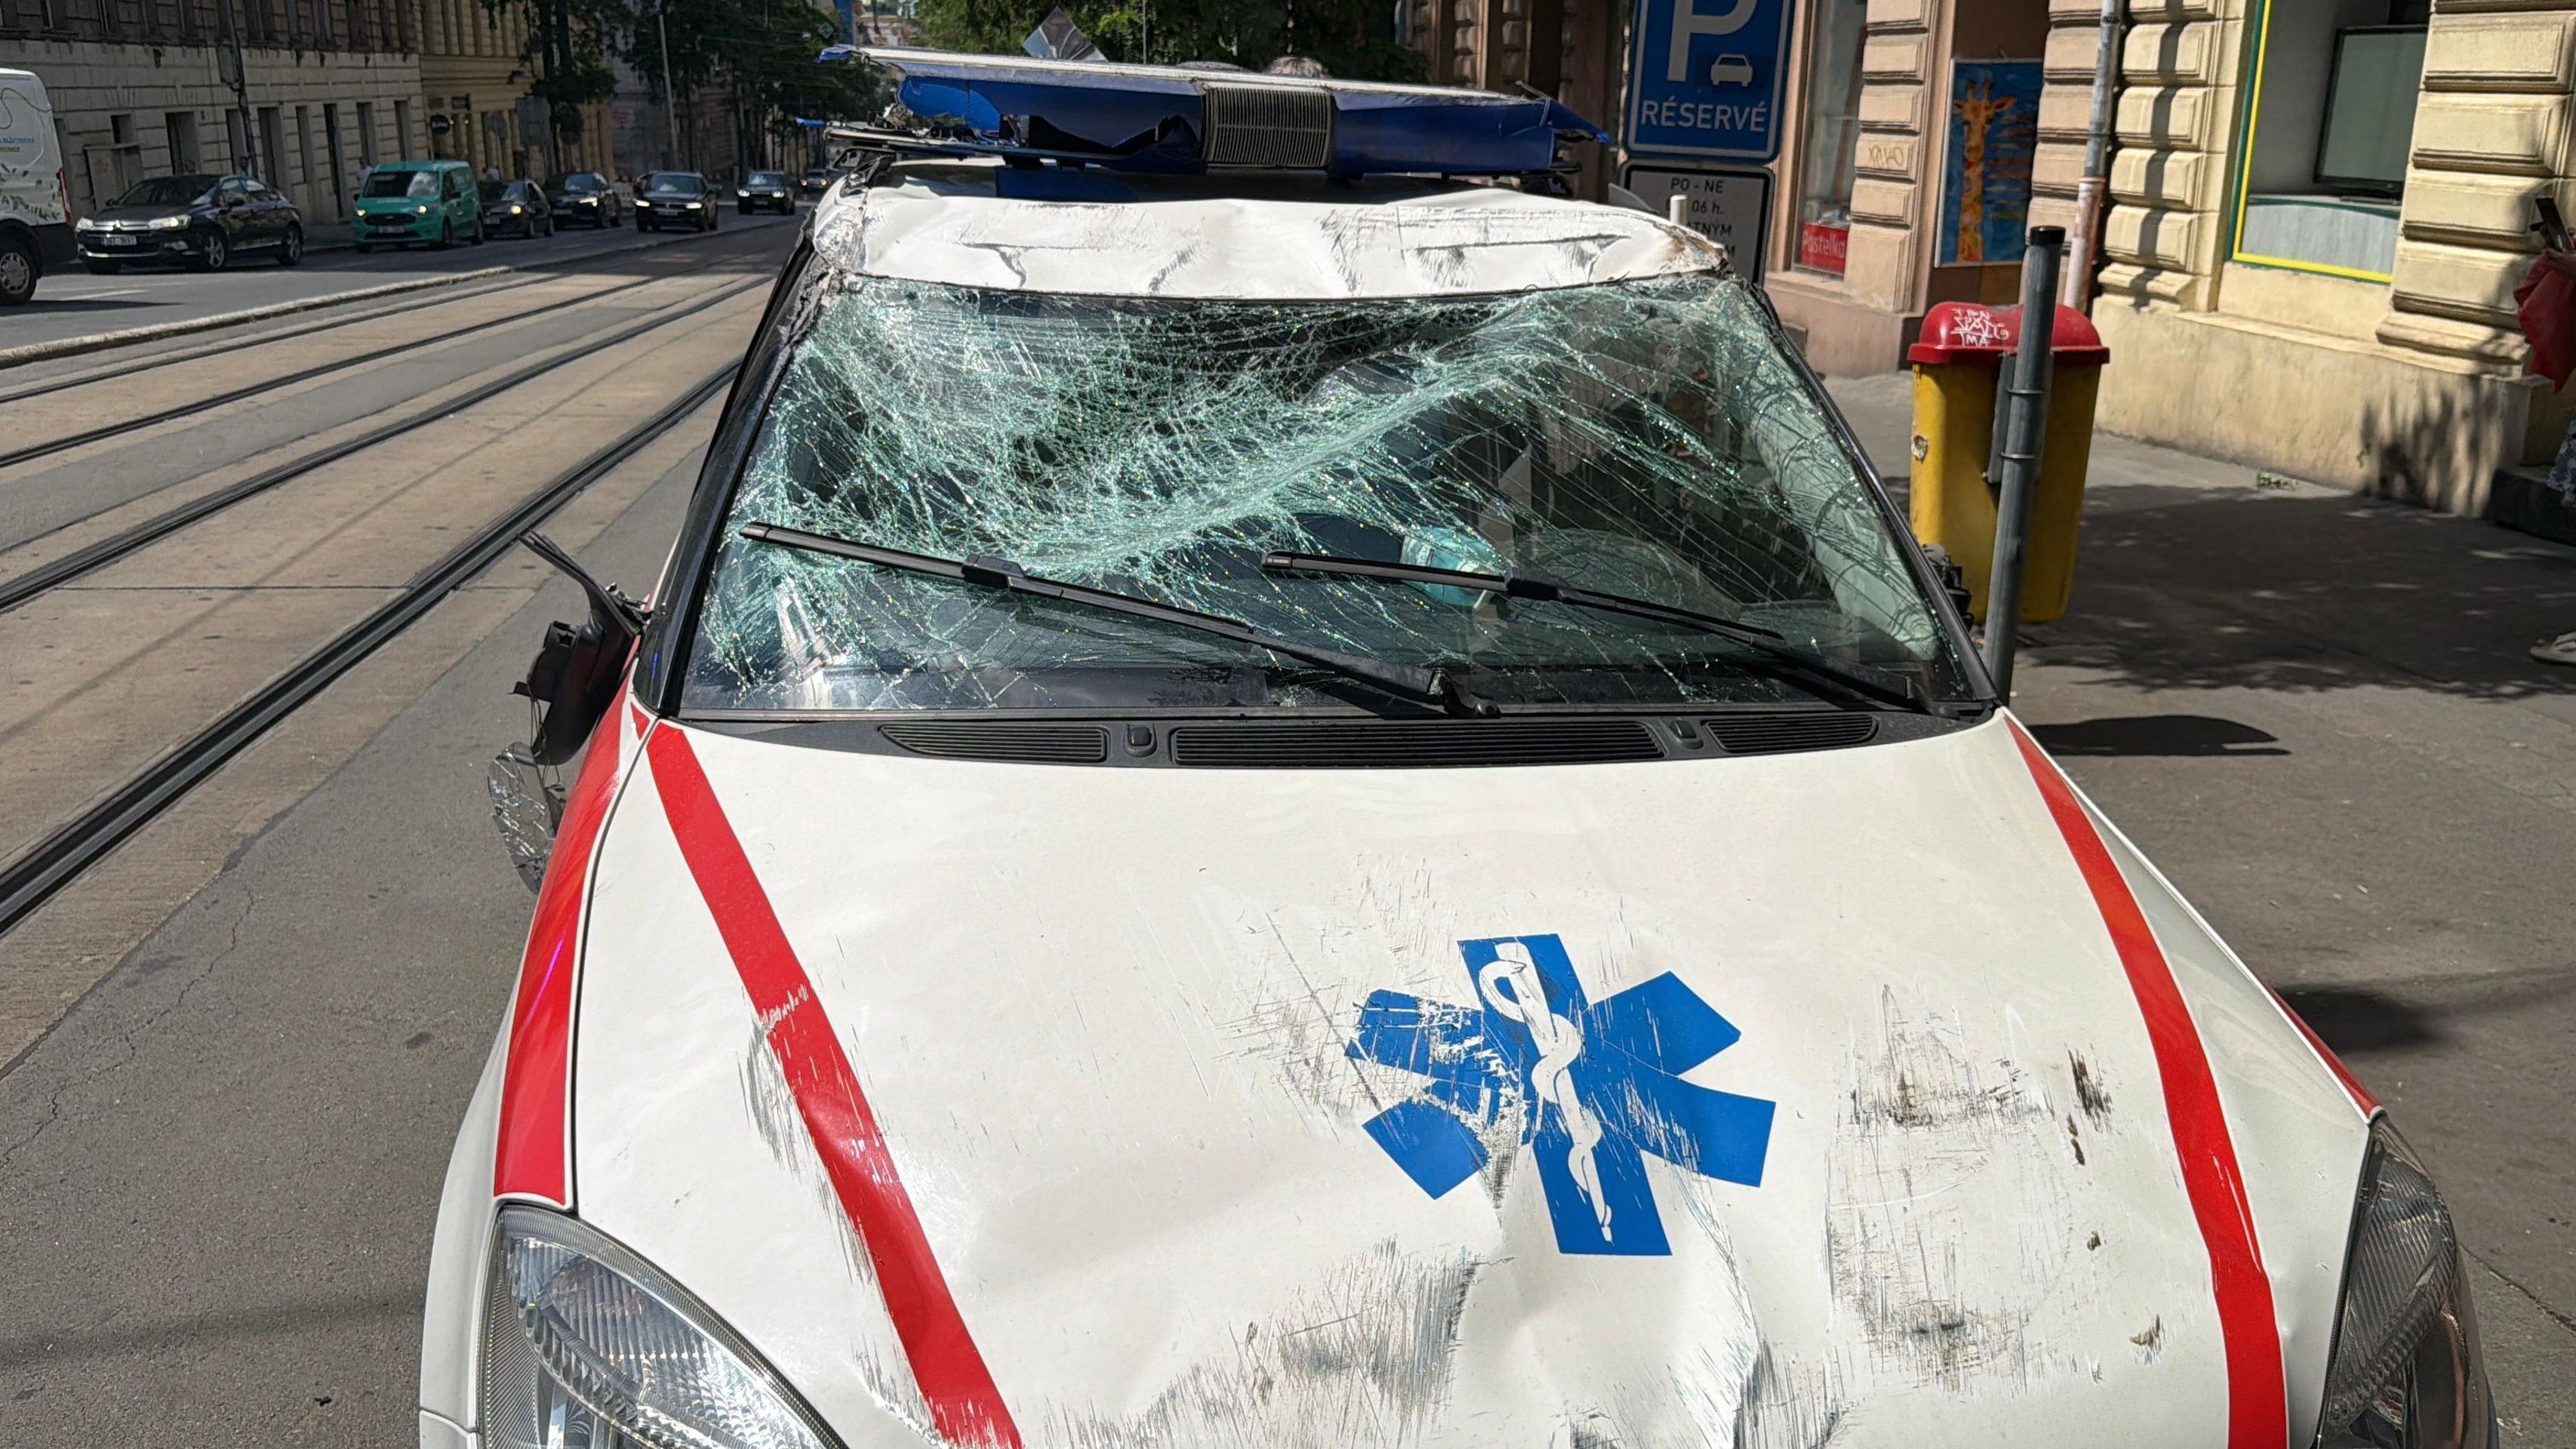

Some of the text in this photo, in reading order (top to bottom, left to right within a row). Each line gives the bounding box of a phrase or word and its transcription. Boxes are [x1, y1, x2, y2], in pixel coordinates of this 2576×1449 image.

[1667, 0, 1757, 82] P
[1641, 96, 1768, 133] RÉSERVÉ
[1670, 178, 1690, 191] PO
[1704, 180, 1725, 193] NE
